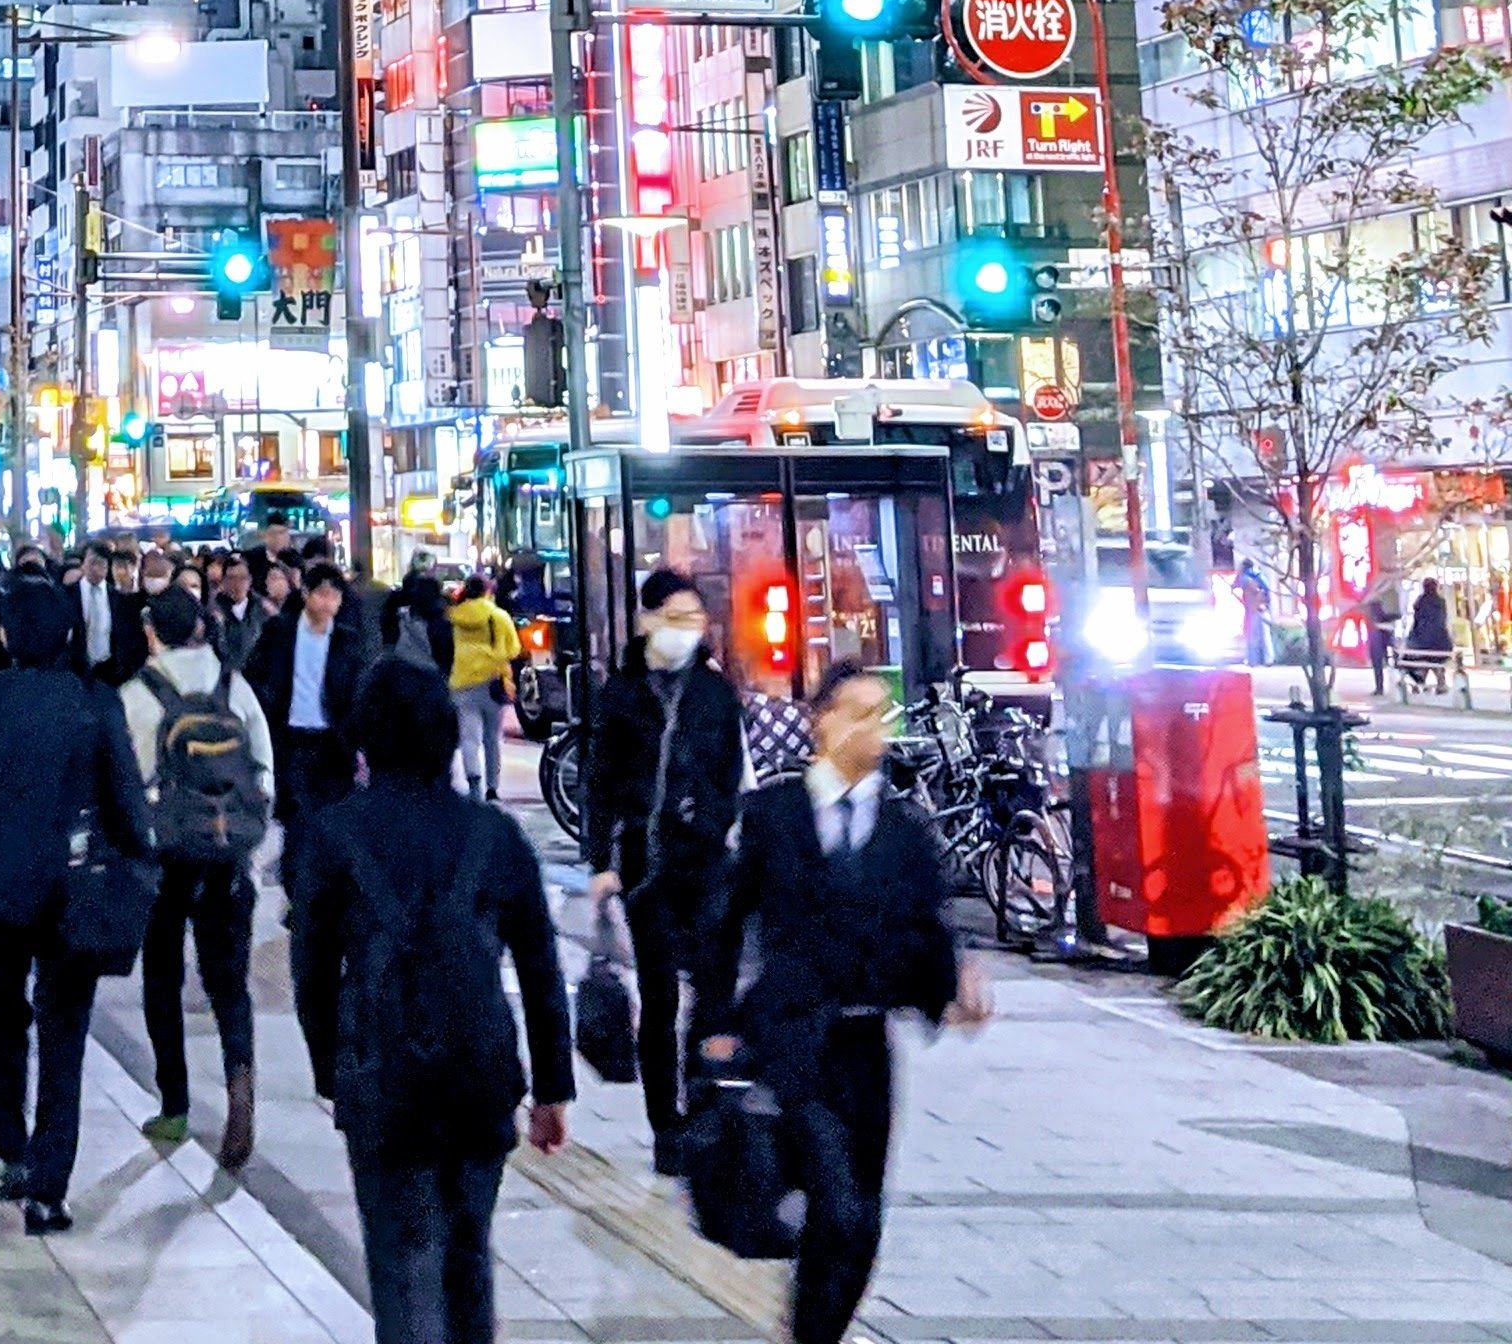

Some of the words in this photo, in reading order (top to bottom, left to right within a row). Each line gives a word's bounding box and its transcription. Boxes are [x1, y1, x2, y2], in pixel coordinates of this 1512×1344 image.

[966, 139, 1005, 161] JRF
[1027, 137, 1057, 152] Turn
[1058, 138, 1092, 153] Right
[272, 289, 332, 326] 大門
[1039, 461, 1072, 506] P
